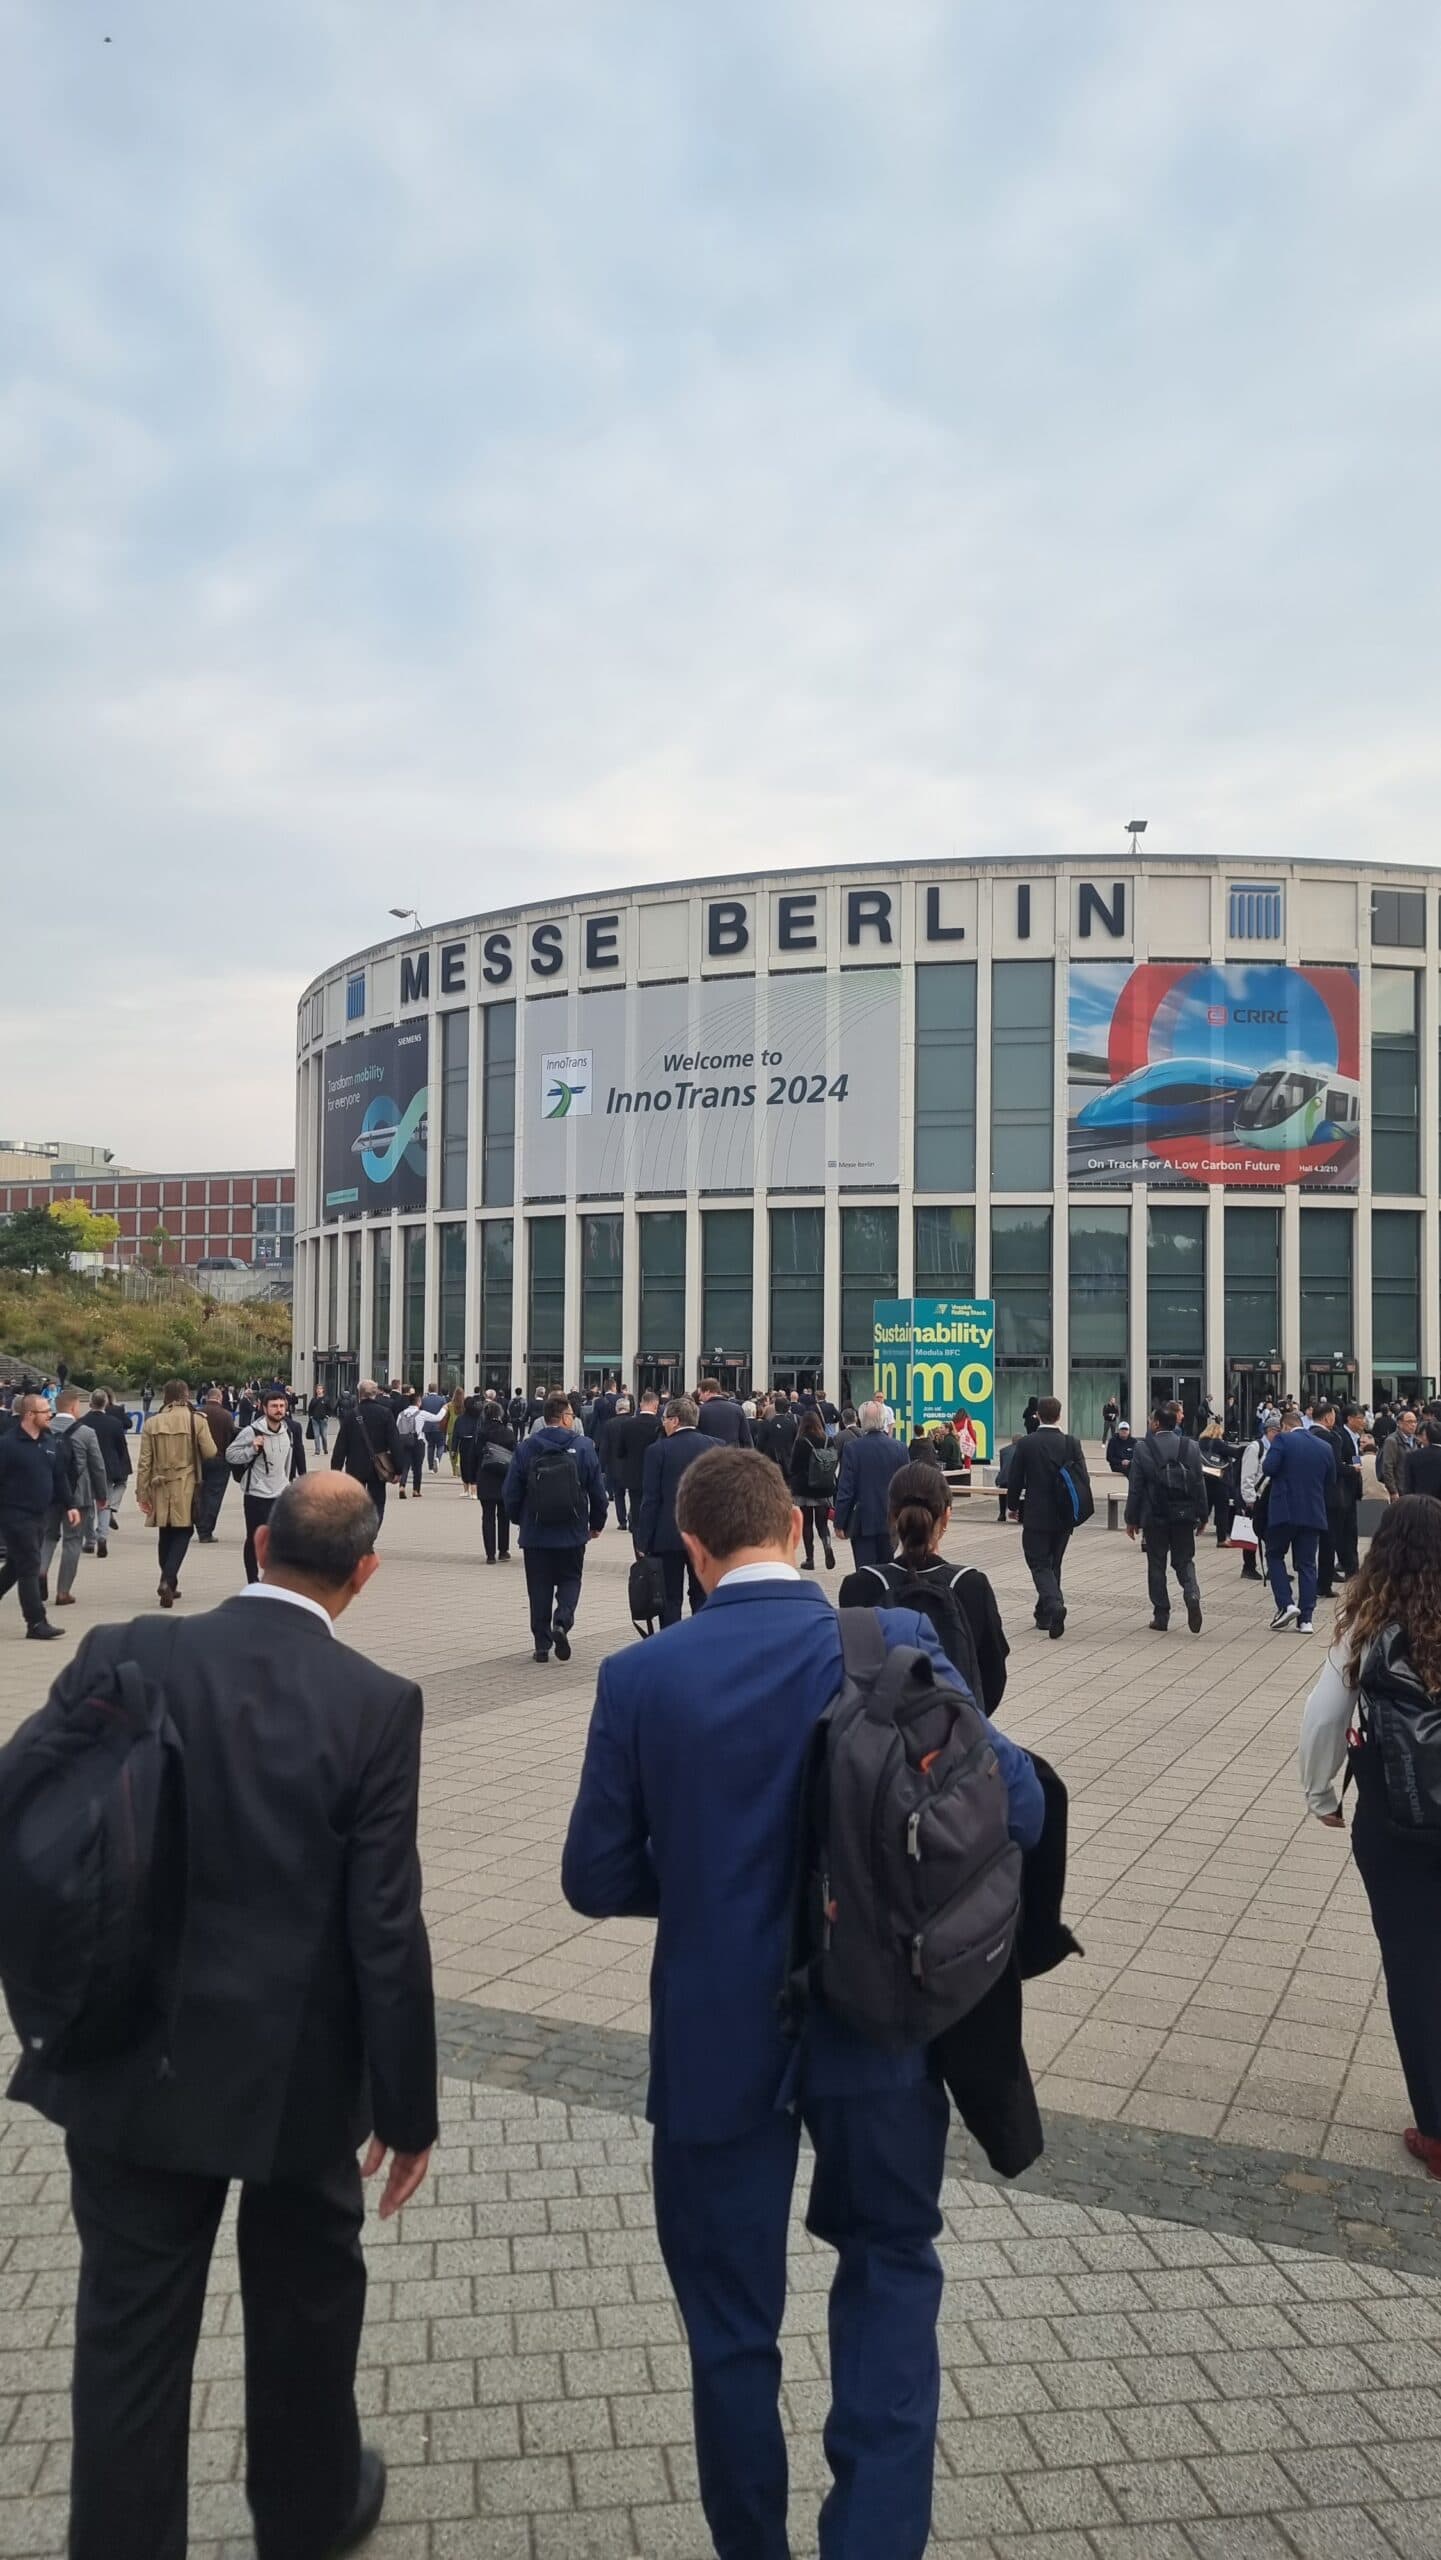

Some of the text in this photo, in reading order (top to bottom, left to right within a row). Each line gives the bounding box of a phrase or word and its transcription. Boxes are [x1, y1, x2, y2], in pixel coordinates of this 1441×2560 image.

[400, 882, 1126, 1003] MESSE BERLIN
[1233, 1009, 1289, 1024] CRRC
[397, 1033, 422, 1046] SIEMENS
[546, 1056, 588, 1071] InnoTrans
[663, 1049, 783, 1073] Welcome to
[327, 1064, 385, 1093] Transform mobility
[334, 1092, 361, 1110] everyone
[606, 1073, 849, 1115] InnoTrans 2024
[1087, 1158, 1281, 1172] On Track For A Low Carbon Future
[1298, 1164, 1313, 1172] Hall
[874, 1322, 993, 1349] Sustainability
